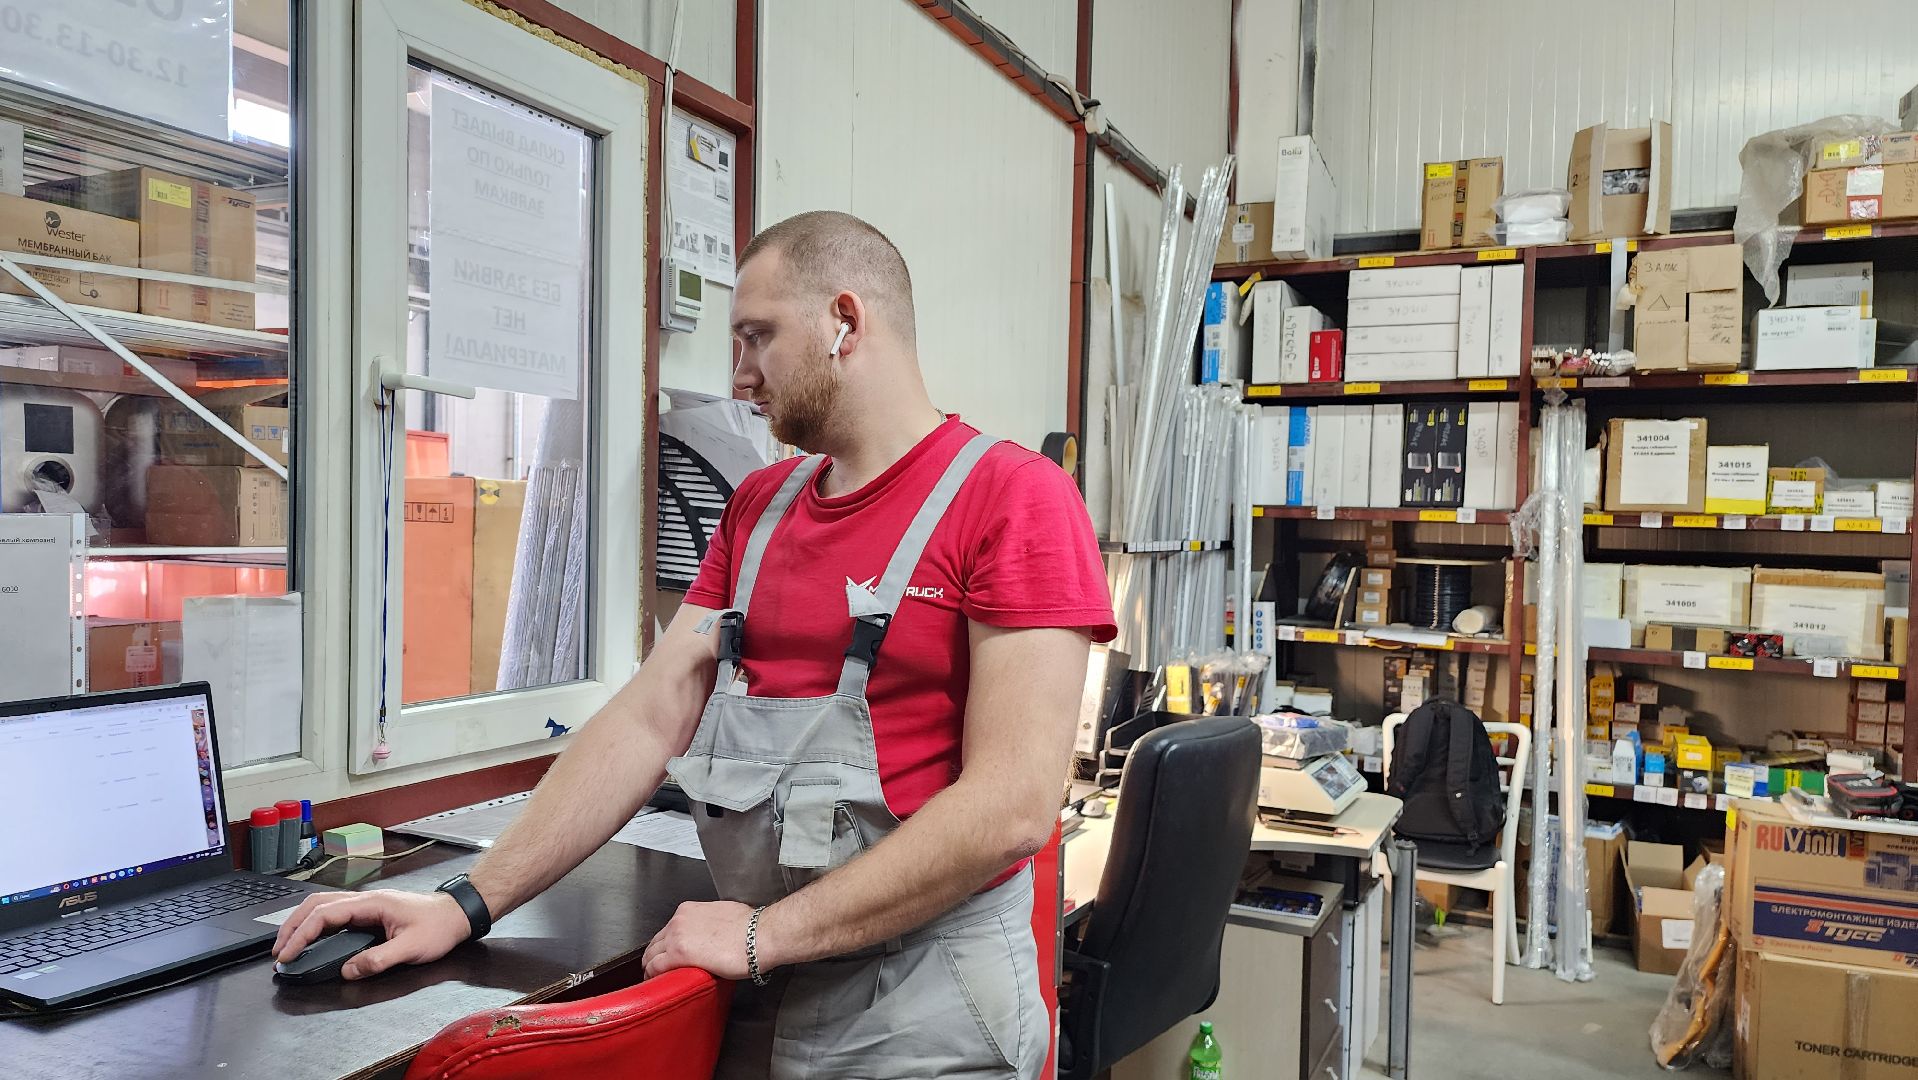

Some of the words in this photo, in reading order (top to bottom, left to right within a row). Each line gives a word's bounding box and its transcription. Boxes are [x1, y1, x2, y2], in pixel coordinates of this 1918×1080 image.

[47, 226, 86, 242] Wester
[18, 238, 91, 259] МЕМБРАННЫЙ
[93, 253, 112, 263] БАК
[1756, 825, 1846, 857] RUVinil
[59, 891, 97, 908] ASUS
[1771, 905, 1884, 926] ЭЛЕКТРОМОНТАЖНЫЕ
[1794, 1040, 1840, 1056] TONER
